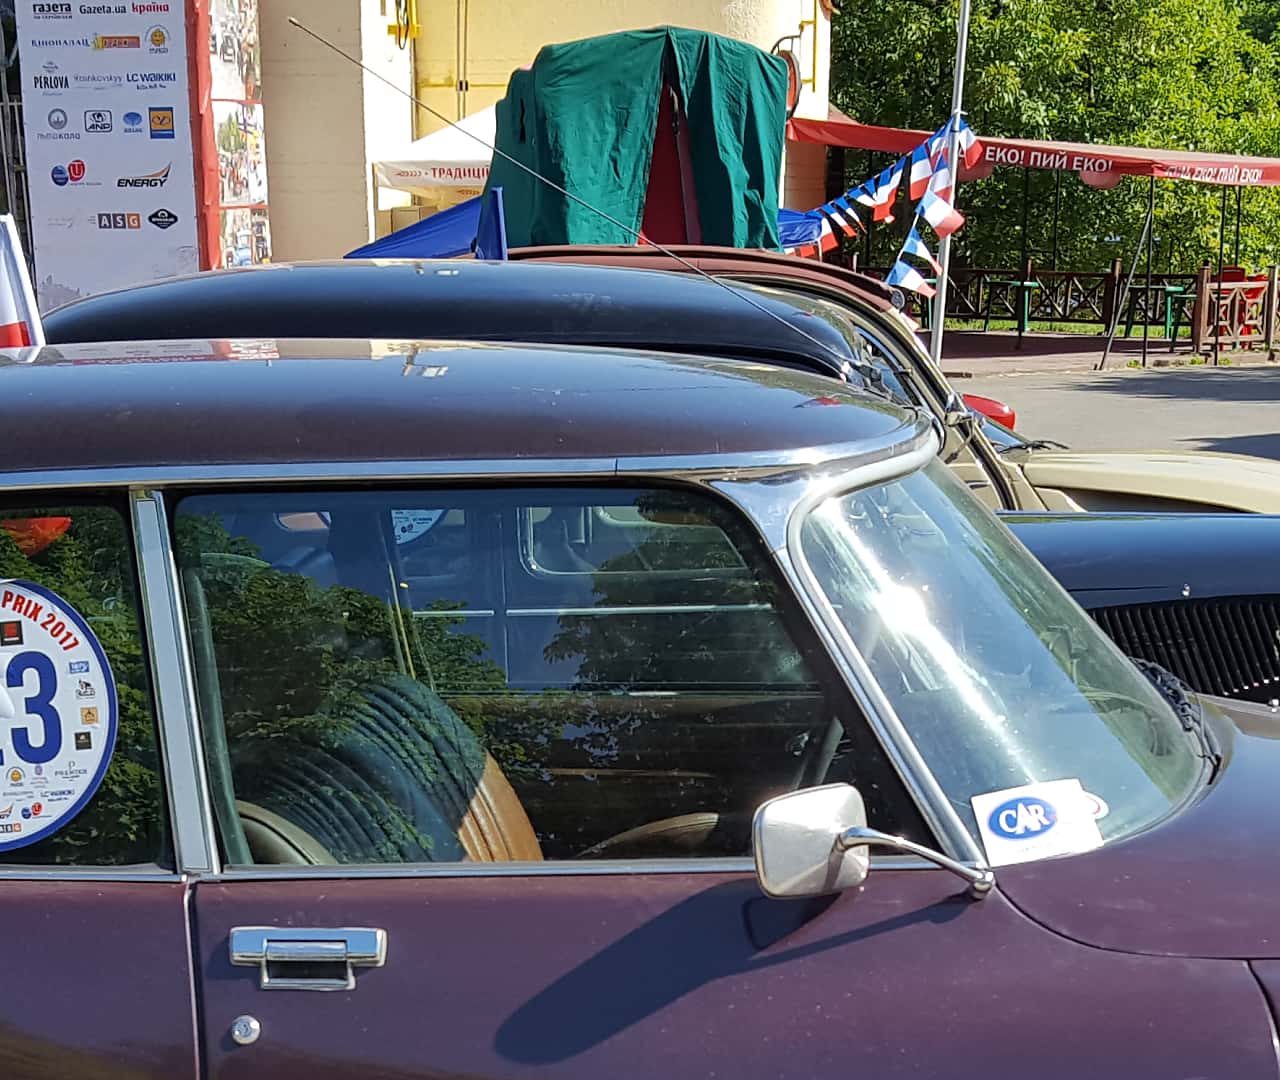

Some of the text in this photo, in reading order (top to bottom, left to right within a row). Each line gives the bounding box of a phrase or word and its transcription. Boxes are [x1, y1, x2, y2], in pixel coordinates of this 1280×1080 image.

[79, 5, 127, 15] Gazeta.ua
[984, 146, 1113, 172] ЕКО! ПИЙ ЕКО!
[117, 178, 167, 187] ENERGY
[98, 213, 141, 229] ASG
[1, 590, 43, 622] PRIX
[40, 613, 79, 651] 2017
[999, 802, 1050, 834] CAR
